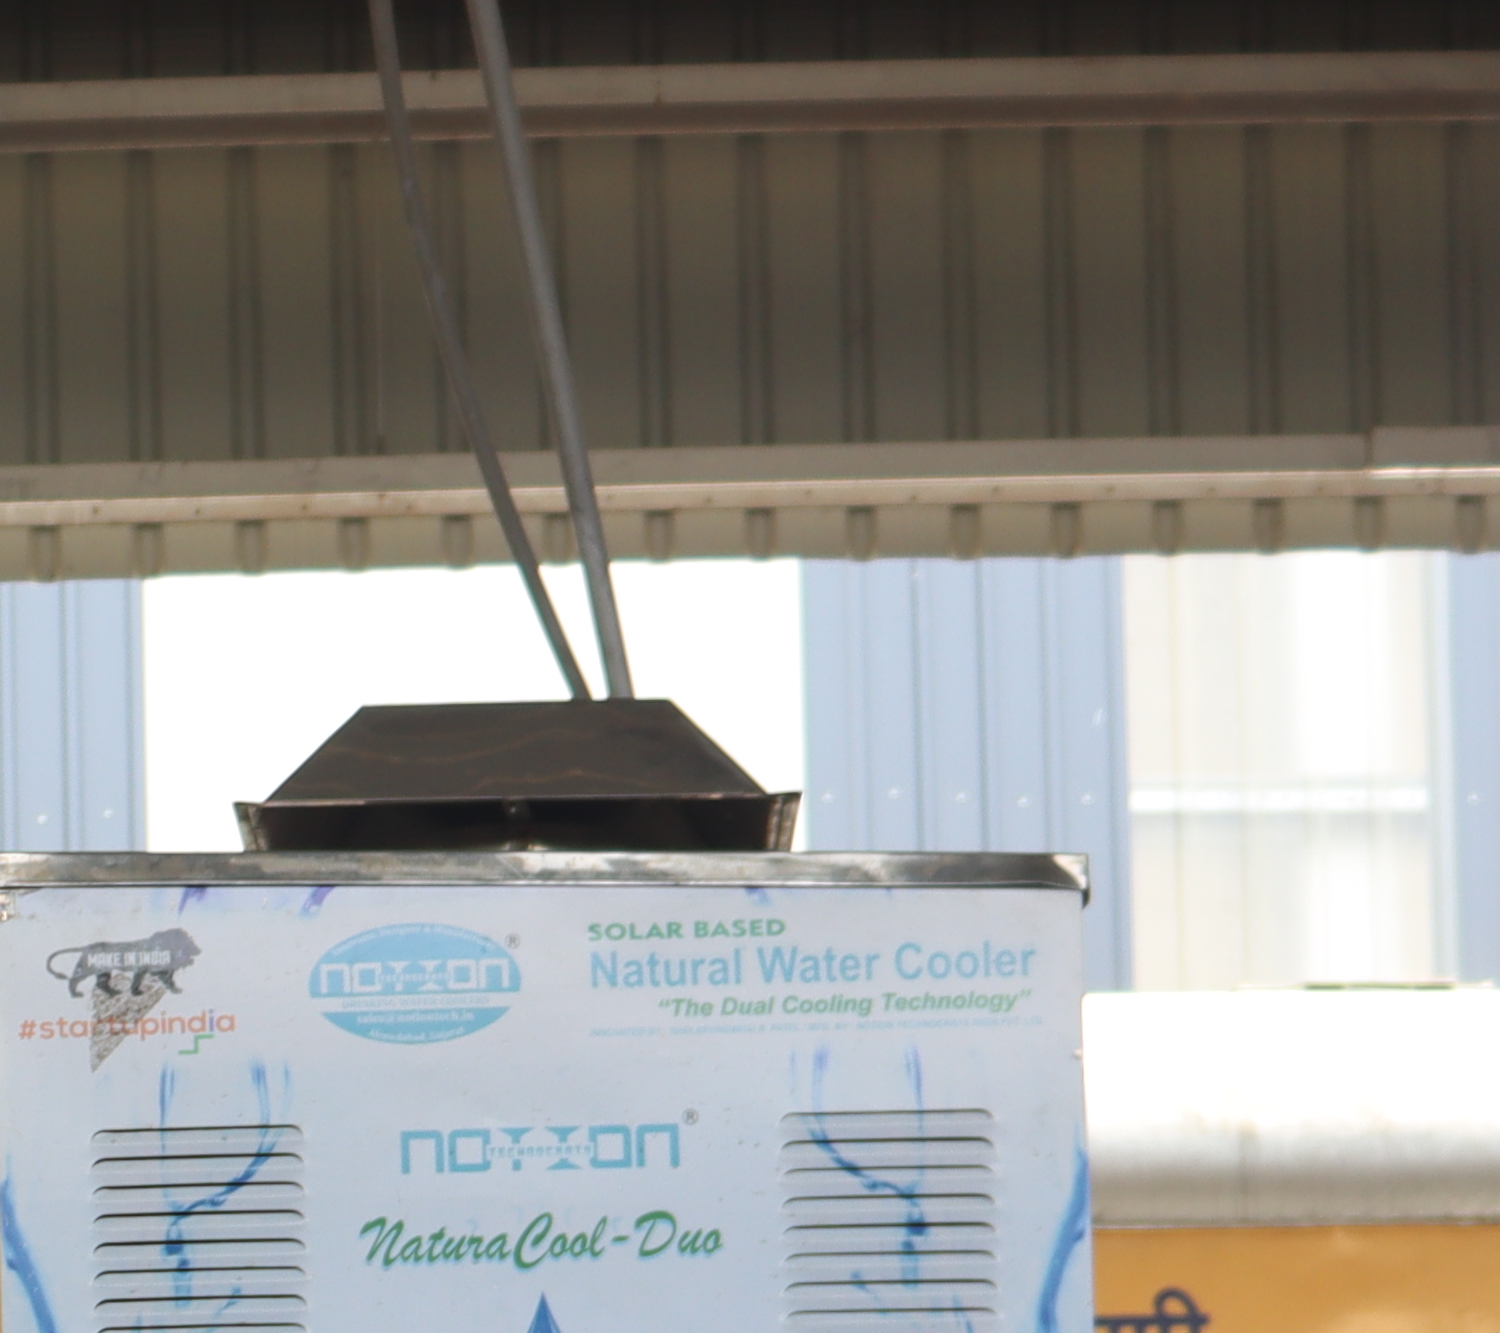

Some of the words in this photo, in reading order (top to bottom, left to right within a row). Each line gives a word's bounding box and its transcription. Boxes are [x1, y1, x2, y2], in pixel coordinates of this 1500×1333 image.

[588, 922, 683, 941] SOLAR
[694, 919, 786, 938] BASED
[87, 951, 121, 967] MAKE
[123, 951, 136, 966] IN
[138, 949, 171, 965] INDIA
[591, 948, 742, 988] Natural
[756, 945, 880, 984] Water
[894, 940, 1036, 980] Cooler
[720, 996, 775, 1016] Dual
[782, 993, 873, 1017] Cooling
[18, 1008, 236, 1042] #startupindia
